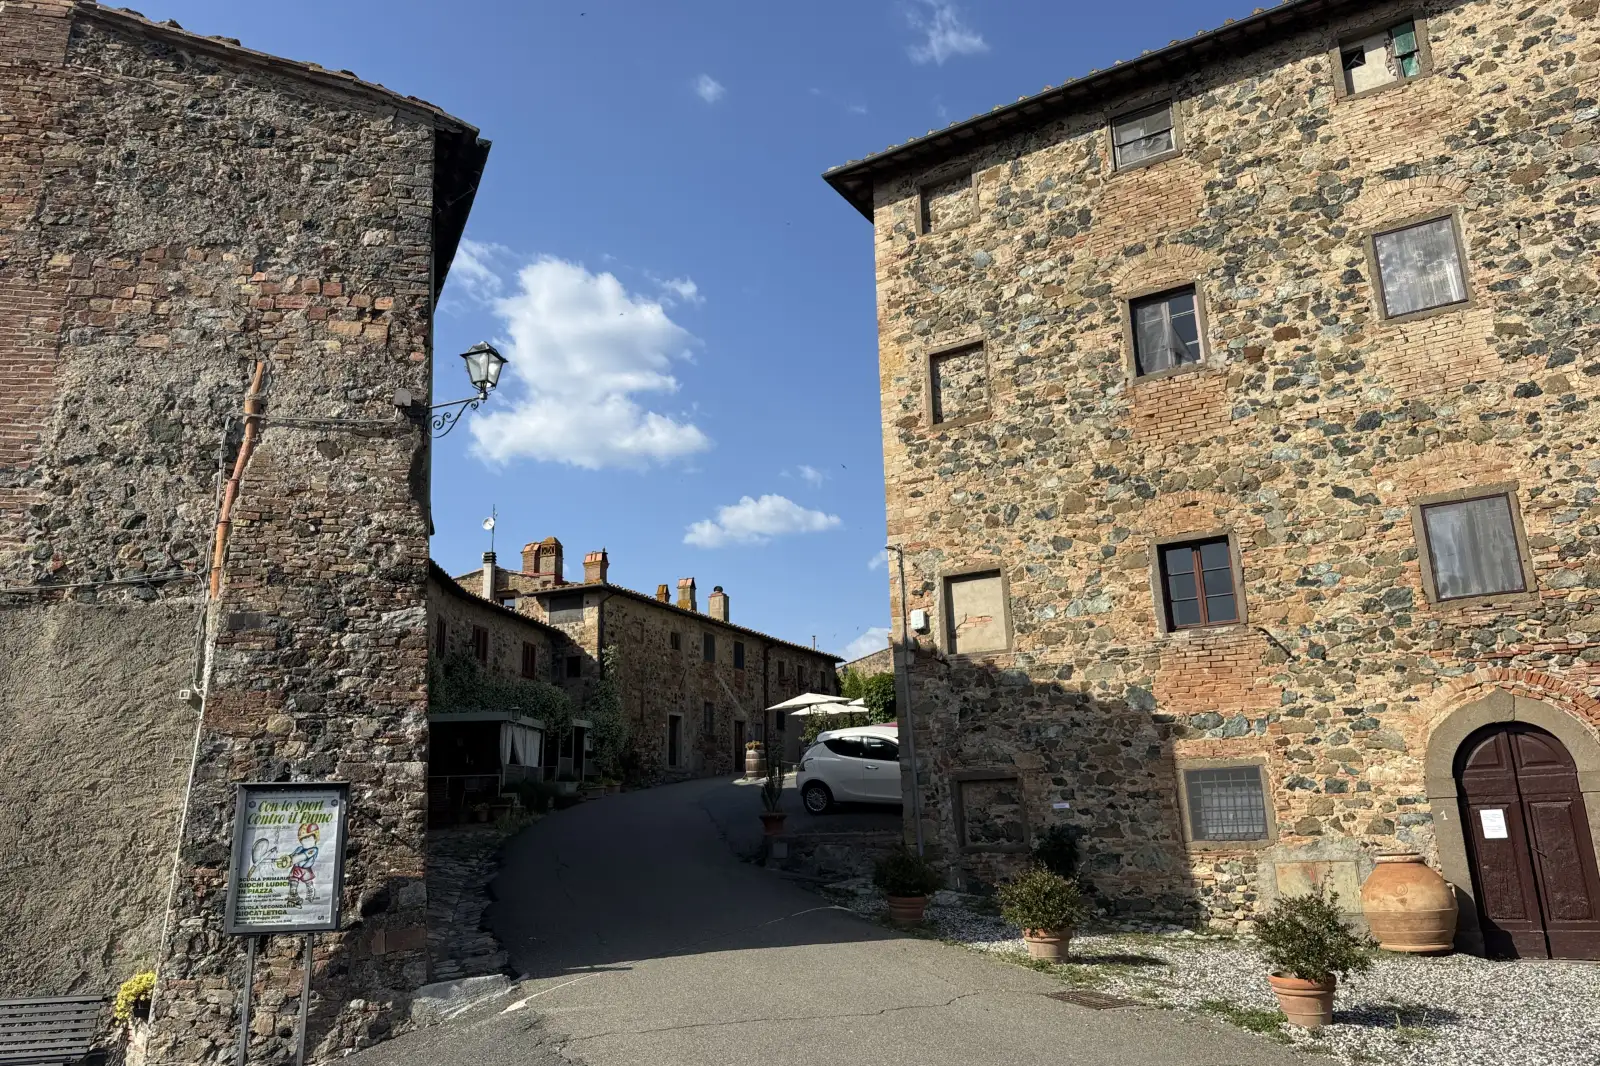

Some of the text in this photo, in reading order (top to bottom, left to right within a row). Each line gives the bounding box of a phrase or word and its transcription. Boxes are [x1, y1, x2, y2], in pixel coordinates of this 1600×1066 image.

[294, 799, 324, 813] Sport
[247, 811, 333, 825] Contro il Fumo
[1440, 810, 1448, 820] 1
